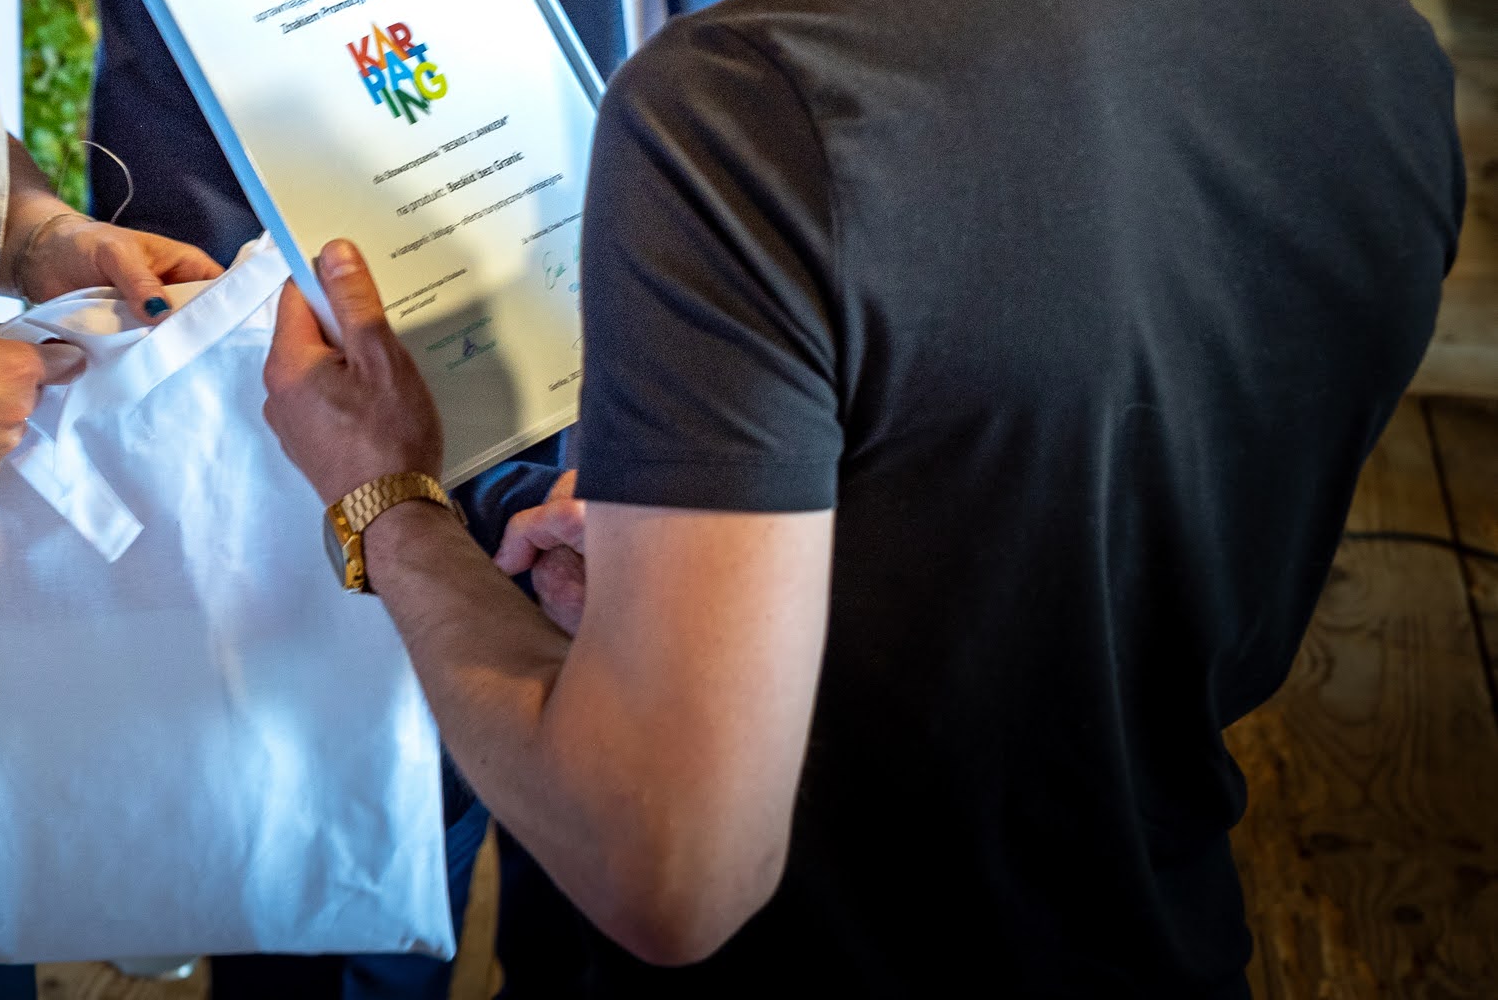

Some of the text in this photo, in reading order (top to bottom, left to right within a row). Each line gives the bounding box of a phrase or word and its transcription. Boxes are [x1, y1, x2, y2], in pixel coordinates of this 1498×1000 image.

[280, 12, 320, 34] Znakiem
[346, 21, 416, 78] KAR
[359, 42, 429, 106] PAT
[380, 61, 448, 125] ING
[396, 206, 410, 217] na
[446, 171, 477, 192] Beskid
[477, 165, 494, 180] bez
[493, 151, 525, 171] Granic
